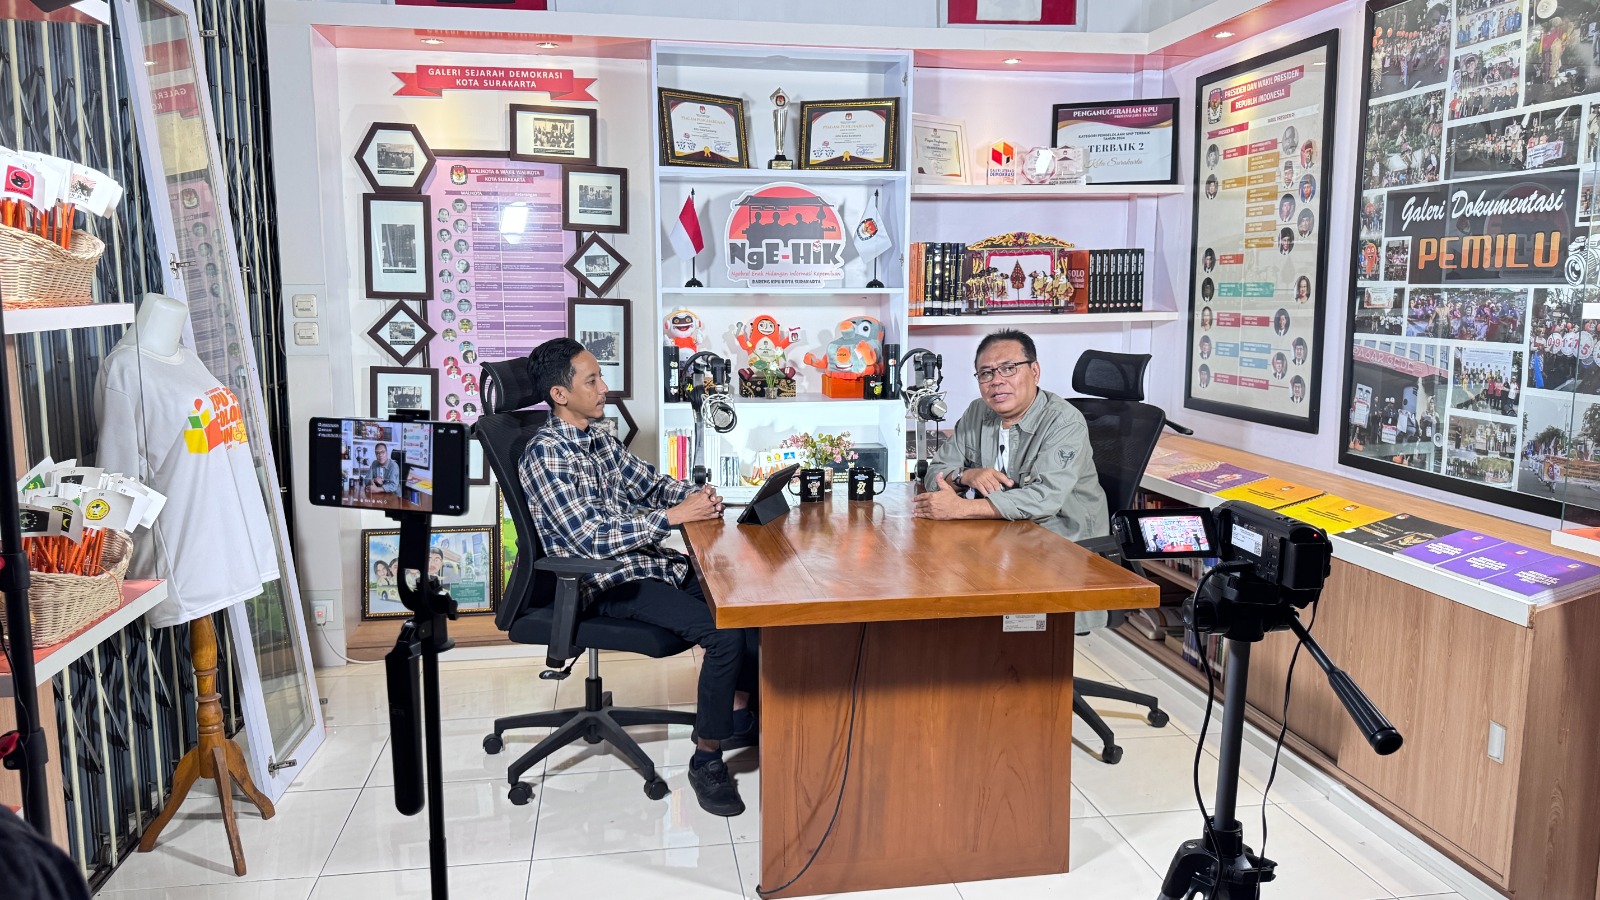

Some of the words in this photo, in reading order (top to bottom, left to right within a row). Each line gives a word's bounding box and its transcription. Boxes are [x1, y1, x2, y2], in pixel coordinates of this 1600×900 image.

[428, 68, 461, 76] GALERI
[465, 69, 504, 78] SEJARAH
[509, 70, 563, 79] DEMOKRASI
[456, 79, 479, 87] KOTA
[483, 80, 537, 88] SURAKARTA
[1224, 86, 1246, 98] PRESIDEN
[1246, 82, 1257, 92] DAN
[1257, 78, 1273, 88] WAKIL
[1273, 69, 1299, 83] PRESIDEN
[1235, 97, 1257, 109] REPUBLIK
[1258, 89, 1285, 102] INDONESIA
[1073, 107, 1142, 117] PENGANUGERAHAN
[1088, 143, 1136, 153] TERBAIK
[1138, 142, 1144, 151] 2
[1084, 158, 1105, 168] Kota
[1106, 157, 1143, 167] Surakarta
[1401, 196, 1446, 231] Galeri
[1451, 188, 1566, 219] Dokumentasi
[1418, 231, 1561, 270] PEMILU
